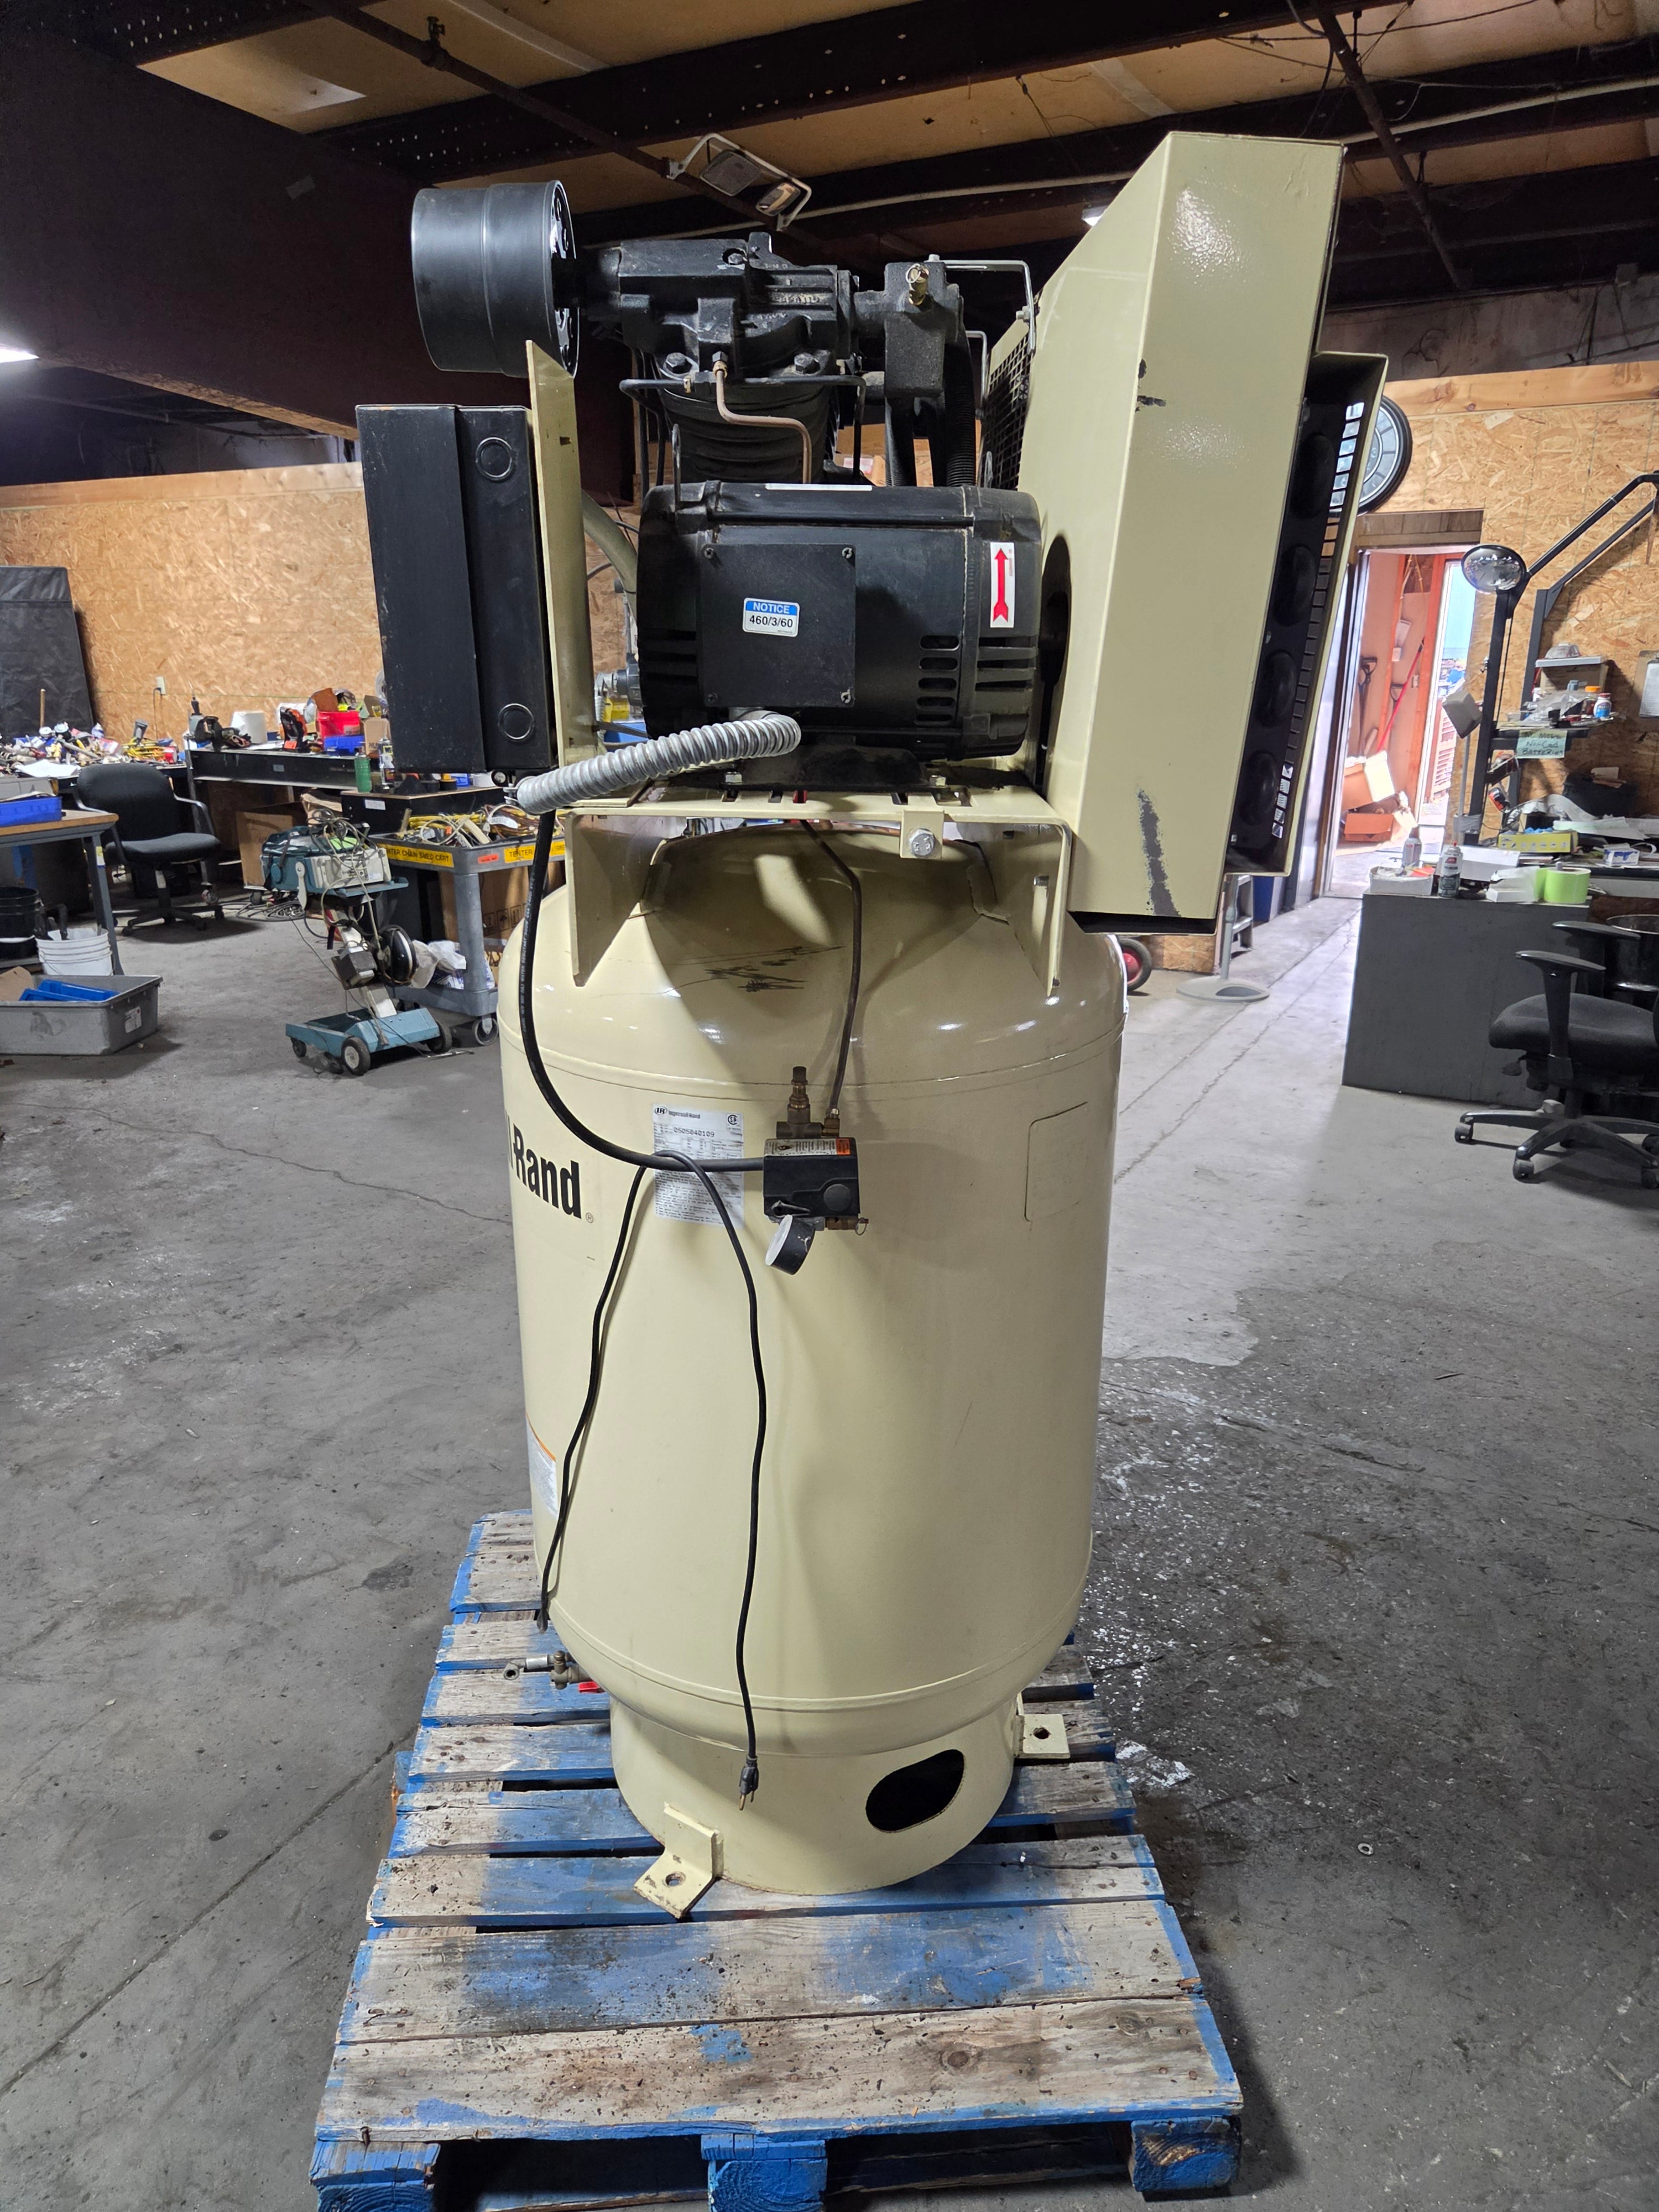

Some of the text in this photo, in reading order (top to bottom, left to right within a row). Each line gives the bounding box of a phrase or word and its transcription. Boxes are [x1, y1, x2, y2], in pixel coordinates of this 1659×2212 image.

[753, 602, 790, 614] NOTICE
[749, 615, 793, 628] 460/3/60
[401, 849, 418, 858] CHAIN
[509, 849, 534, 858] TENTER
